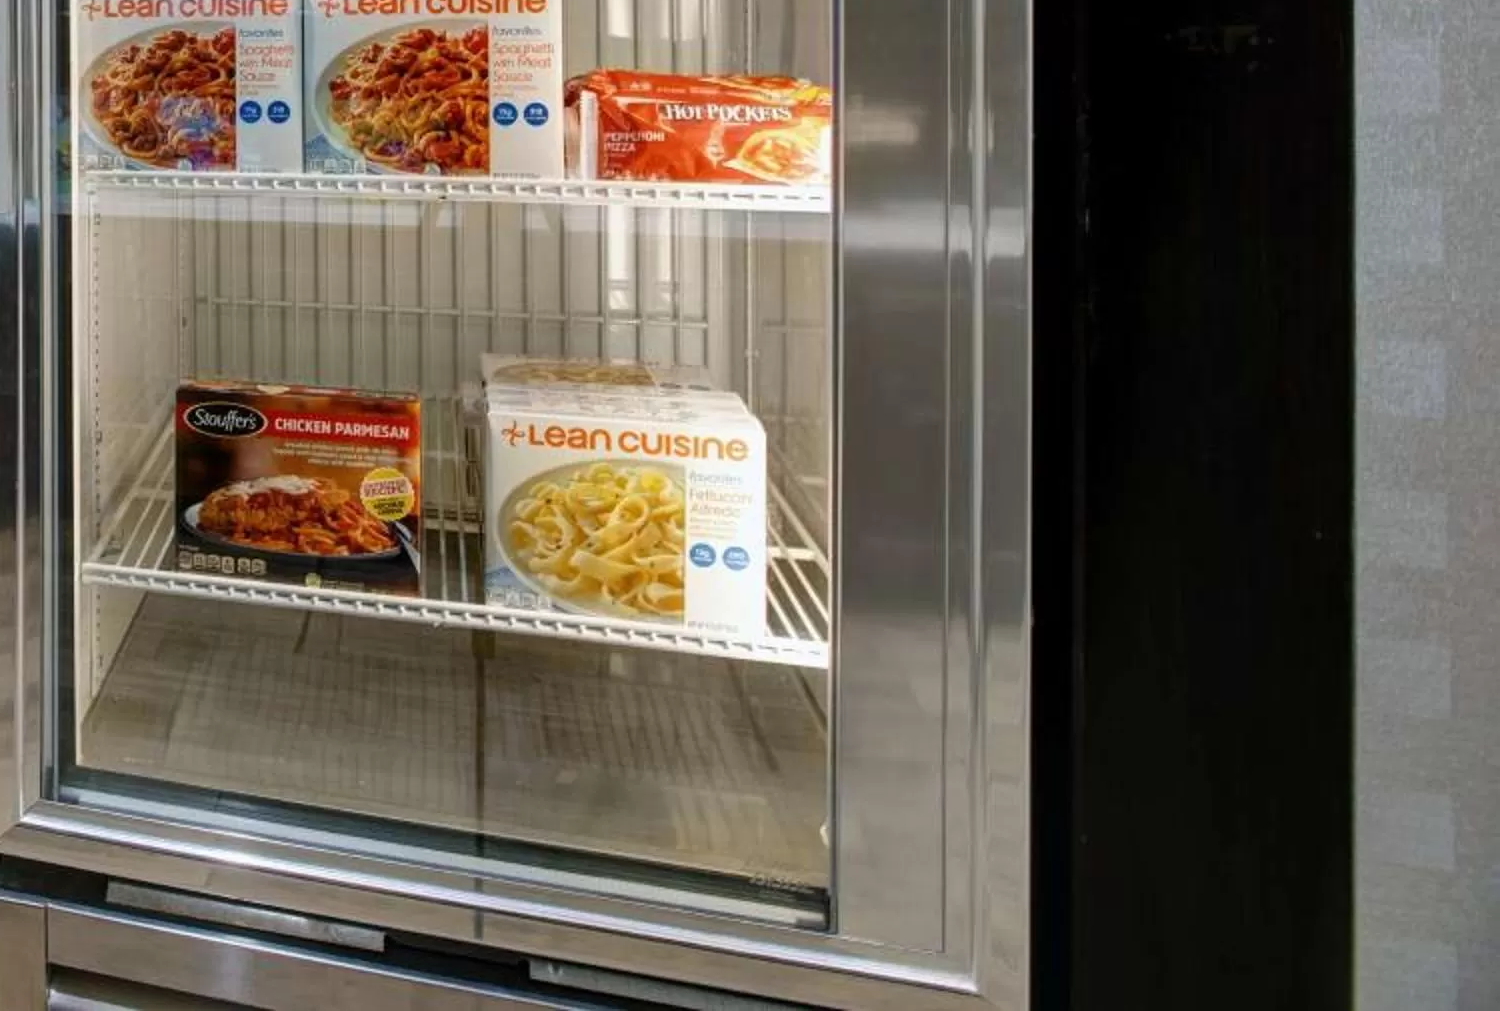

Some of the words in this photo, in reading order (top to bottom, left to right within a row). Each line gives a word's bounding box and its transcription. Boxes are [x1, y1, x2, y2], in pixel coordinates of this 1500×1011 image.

[603, 142, 637, 152] PIZZA
[193, 408, 258, 432] Stouffer's
[274, 417, 332, 435] CHICKEN
[334, 422, 410, 440] PARMESAN
[528, 423, 612, 451] Lean
